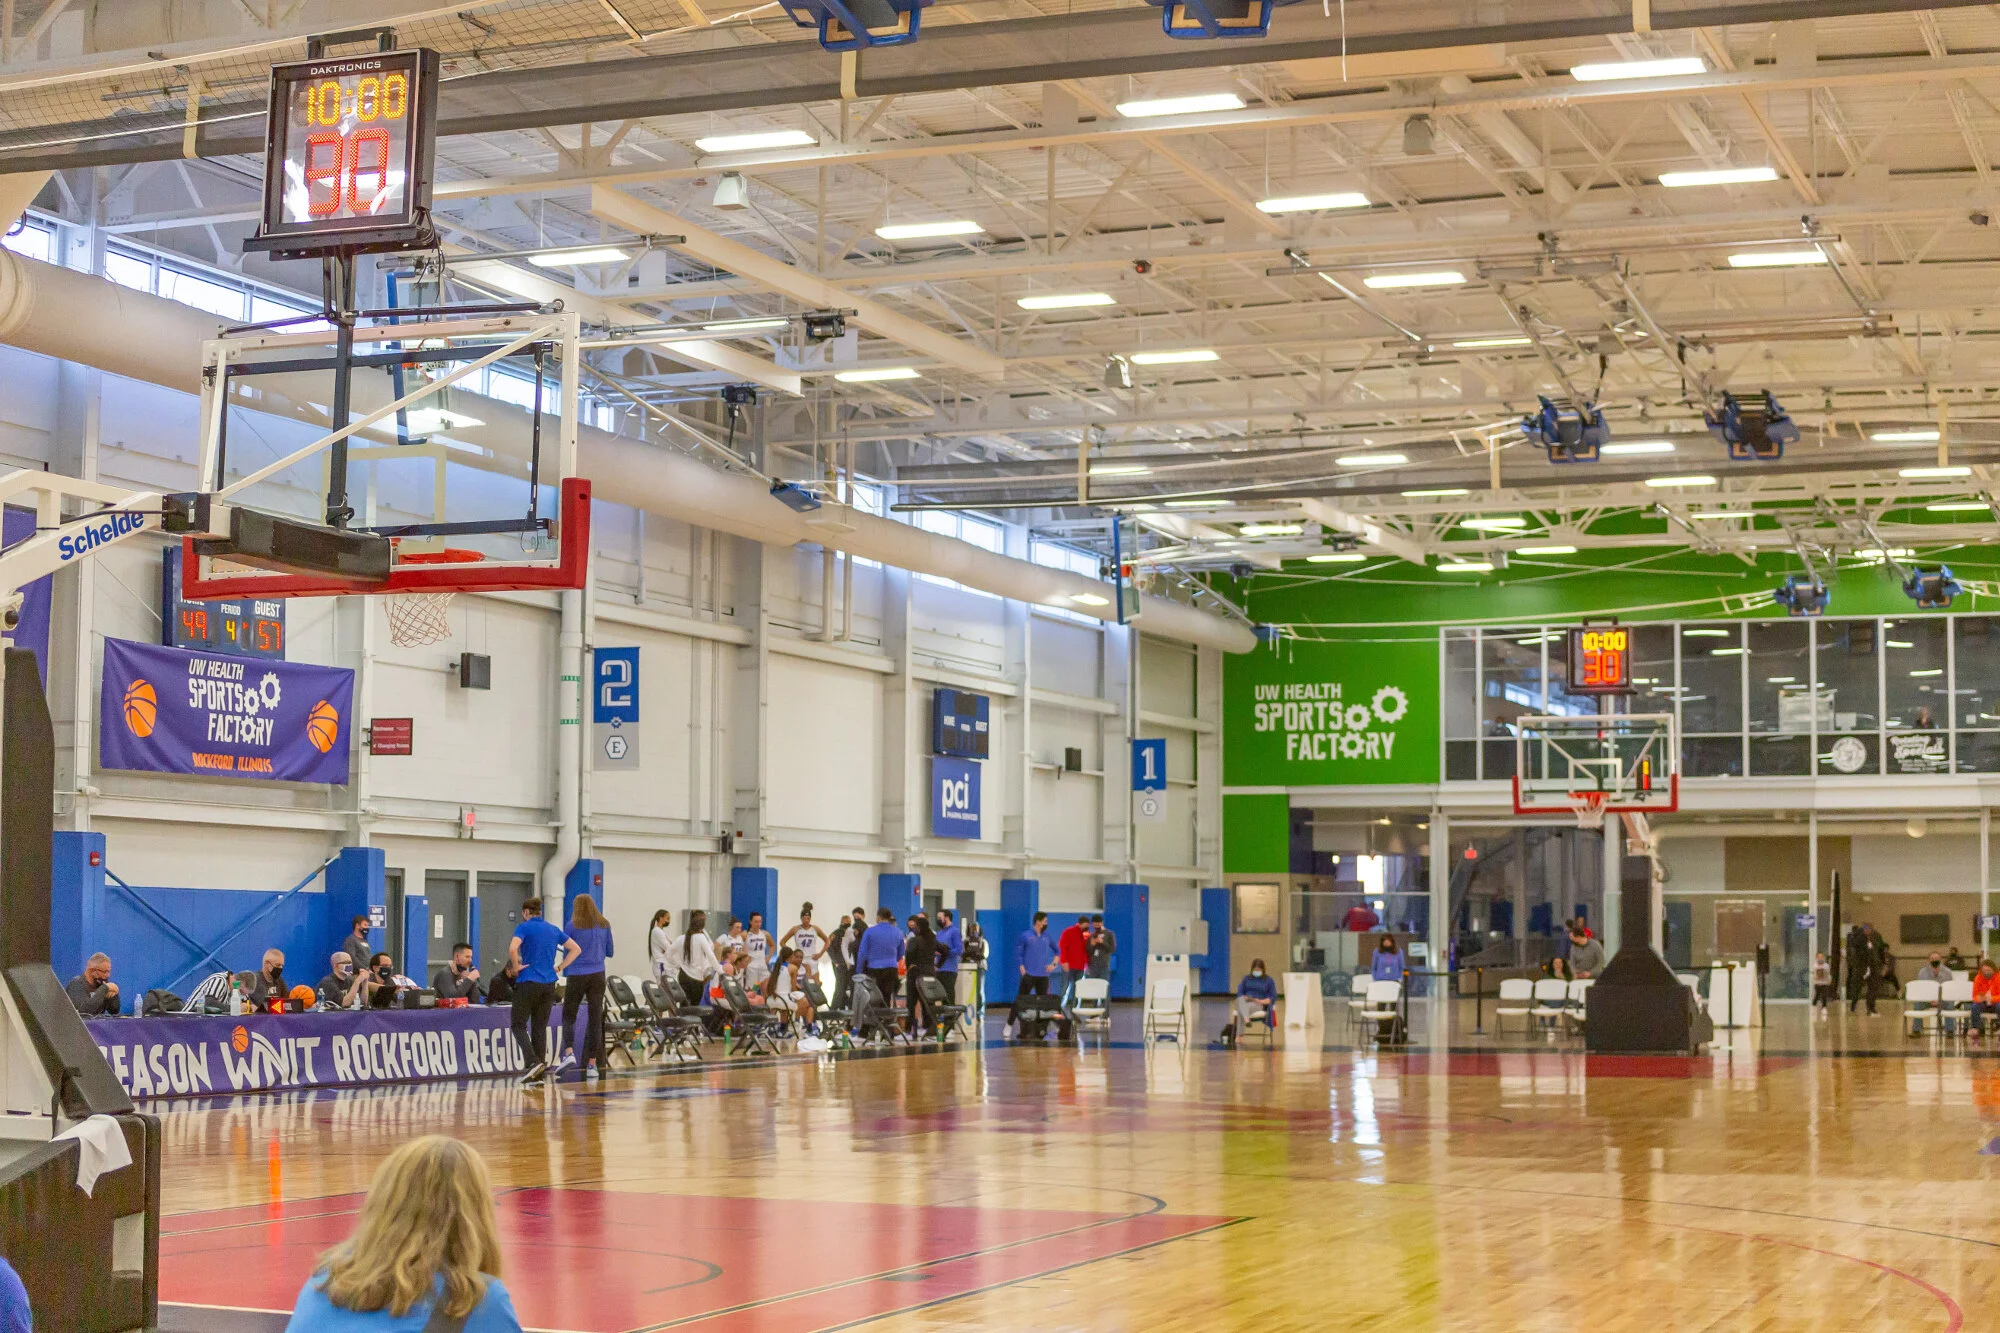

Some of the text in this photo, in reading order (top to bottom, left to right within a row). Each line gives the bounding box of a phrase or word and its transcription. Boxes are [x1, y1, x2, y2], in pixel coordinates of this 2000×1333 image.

[310, 61, 382, 76] DAKTRONICS
[307, 74, 406, 127] 10:00
[58, 509, 144, 560] Schelde
[221, 600, 281, 617] PERIOD GUEST
[182, 610, 282, 650] 49 4 57
[1582, 631, 1627, 651] 10:00
[188, 658, 245, 681] UW HEALTH
[601, 659, 632, 707] 2
[1583, 650, 1621, 685] 30
[188, 677, 244, 713] SPORTS
[1254, 682, 1342, 701] UW HEALTH
[207, 712, 274, 747] FACTORY
[1254, 701, 1343, 732] SPORTS
[611, 741, 621, 754] E
[1286, 731, 1396, 761] FACTORY
[237, 756, 273, 773] ILLINOIS
[1141, 747, 1157, 780] 1
[941, 772, 969, 818] pci
[332, 1030, 458, 1082] ROCKFORD
[464, 1025, 563, 1074] REGIOAL
